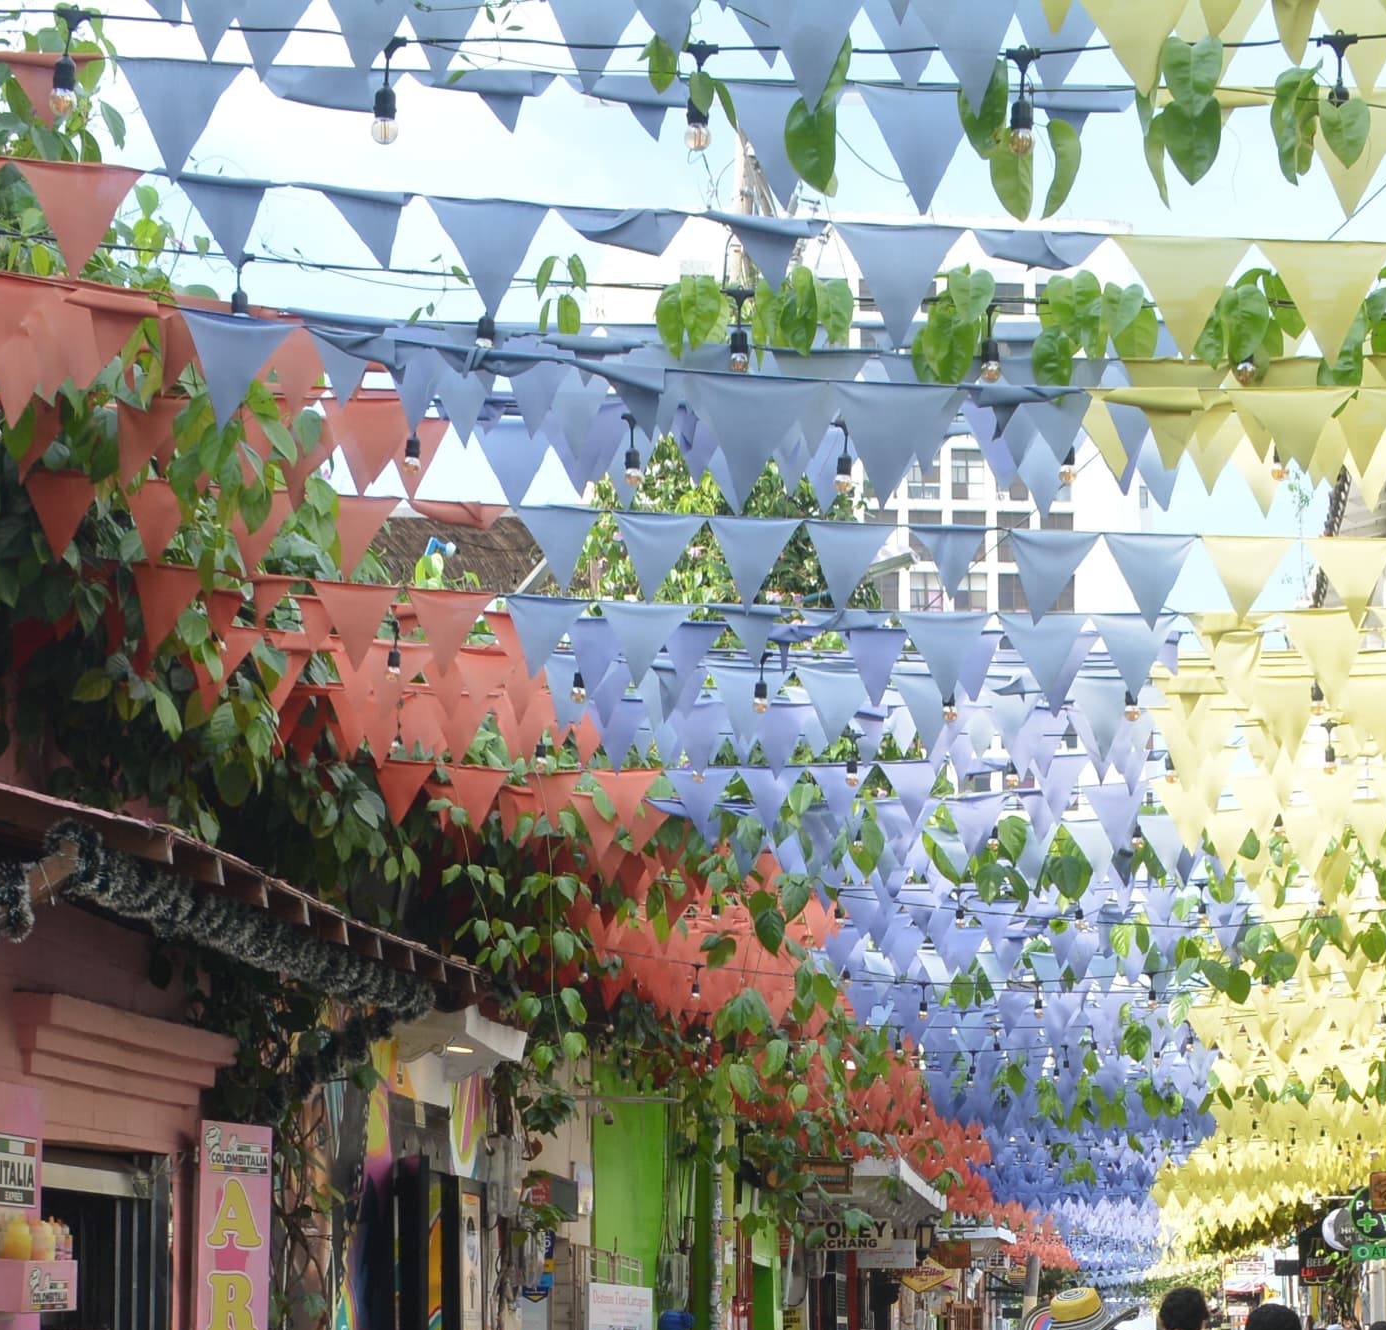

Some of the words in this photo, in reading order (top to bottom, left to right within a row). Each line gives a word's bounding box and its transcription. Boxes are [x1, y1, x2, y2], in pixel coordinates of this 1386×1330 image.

[211, 1151, 268, 1167] COLOMBITALIA
[807, 1220, 888, 1239] OEY
[813, 1238, 878, 1249] XCHANG
